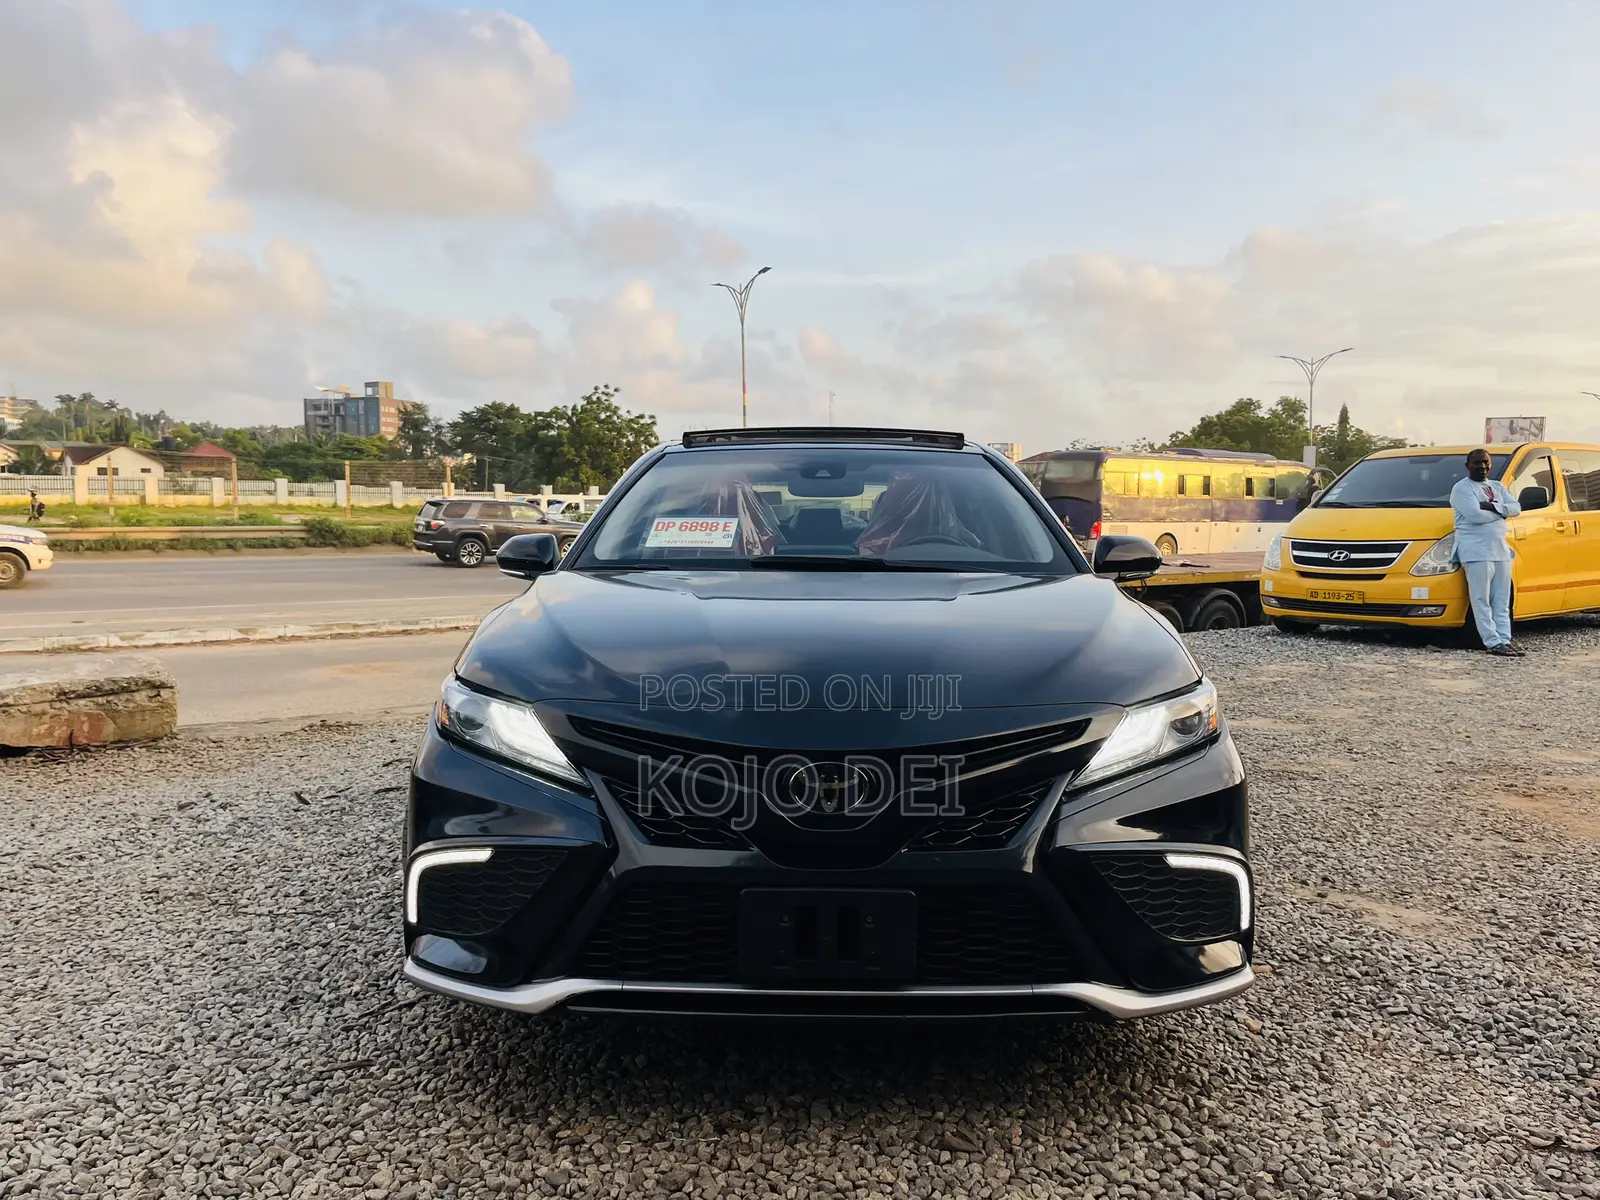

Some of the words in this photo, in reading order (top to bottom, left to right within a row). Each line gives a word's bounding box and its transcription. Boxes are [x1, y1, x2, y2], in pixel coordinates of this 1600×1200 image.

[654, 521, 676, 532] DP
[678, 521, 720, 532] 6898
[722, 521, 733, 532] E
